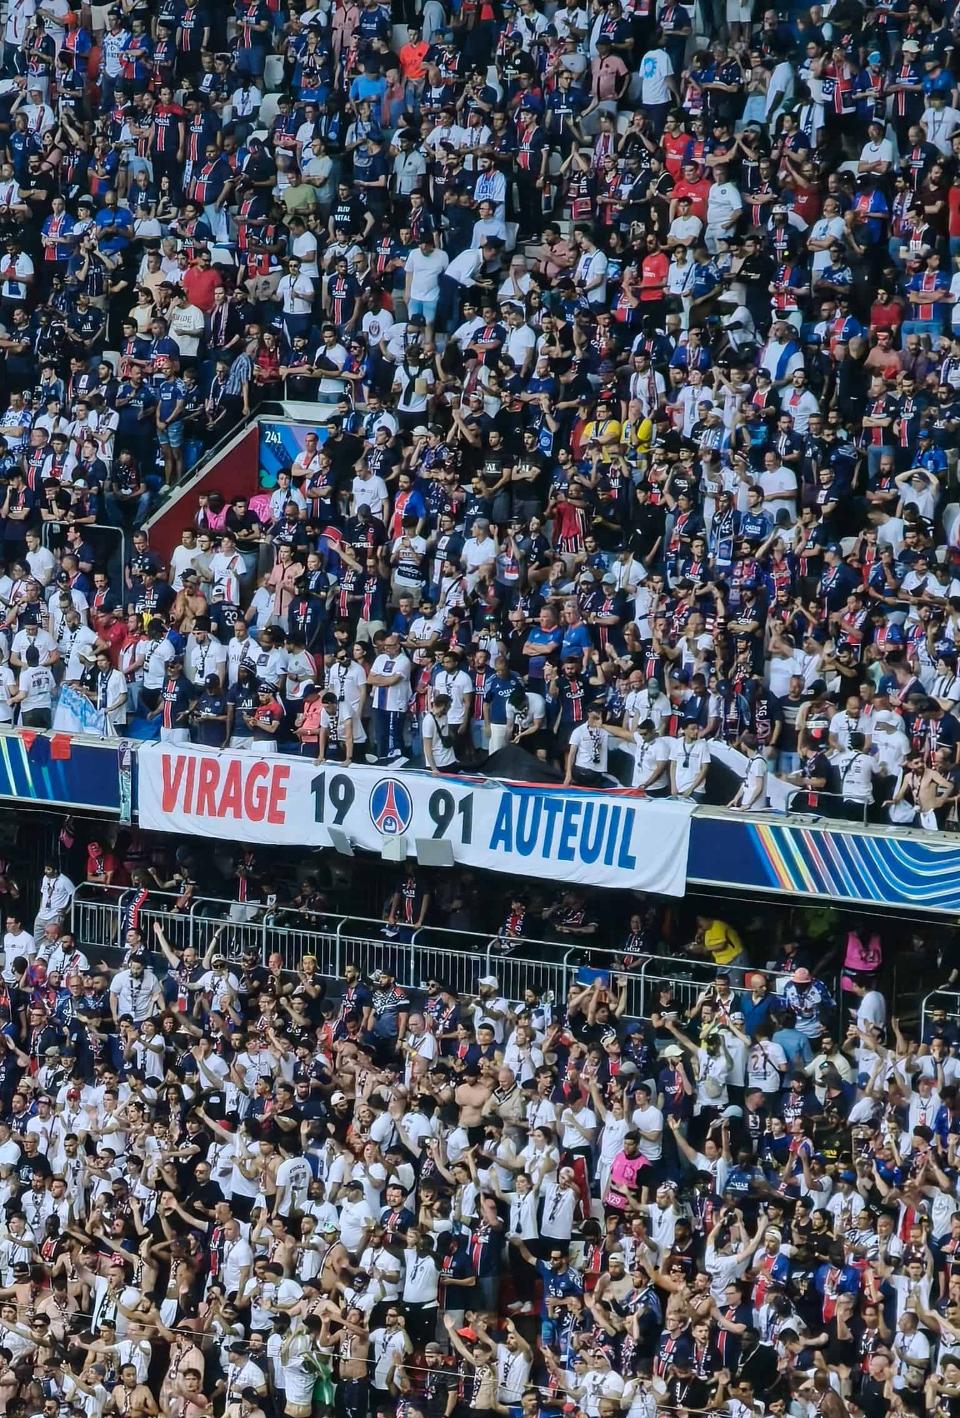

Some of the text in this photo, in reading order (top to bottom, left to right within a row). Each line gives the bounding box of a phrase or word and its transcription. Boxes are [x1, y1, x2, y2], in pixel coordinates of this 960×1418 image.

[265, 431, 282, 444] 241
[161, 754, 291, 825] VIRAGE
[310, 771, 356, 825] 19
[428, 788, 474, 845] 91
[489, 791, 637, 870] AUTEUIL
